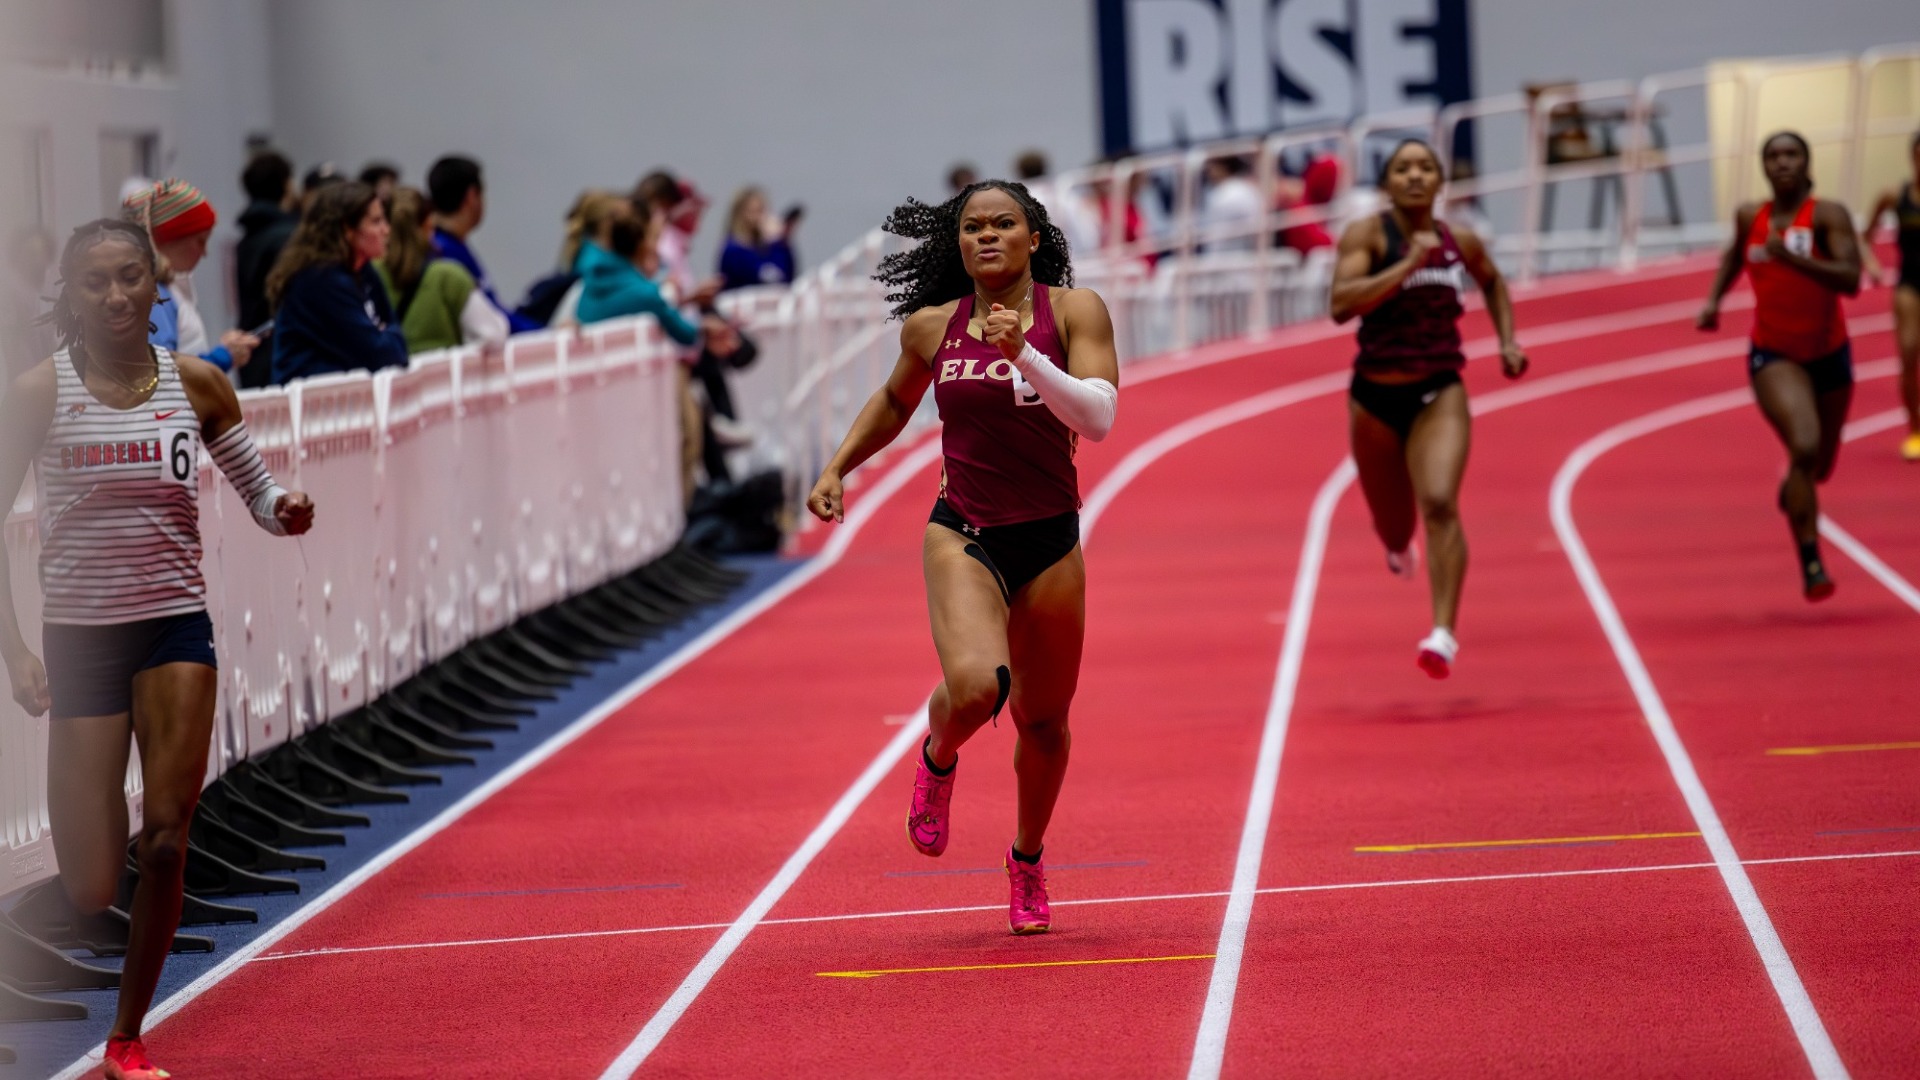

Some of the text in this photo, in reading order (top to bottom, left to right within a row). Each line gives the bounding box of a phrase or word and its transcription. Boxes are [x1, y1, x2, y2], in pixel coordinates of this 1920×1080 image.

[1130, 0, 1438, 148] RISE
[938, 358, 1013, 384] ELO
[60, 441, 162, 469] CUMBERLA
[171, 432, 190, 481] 6
